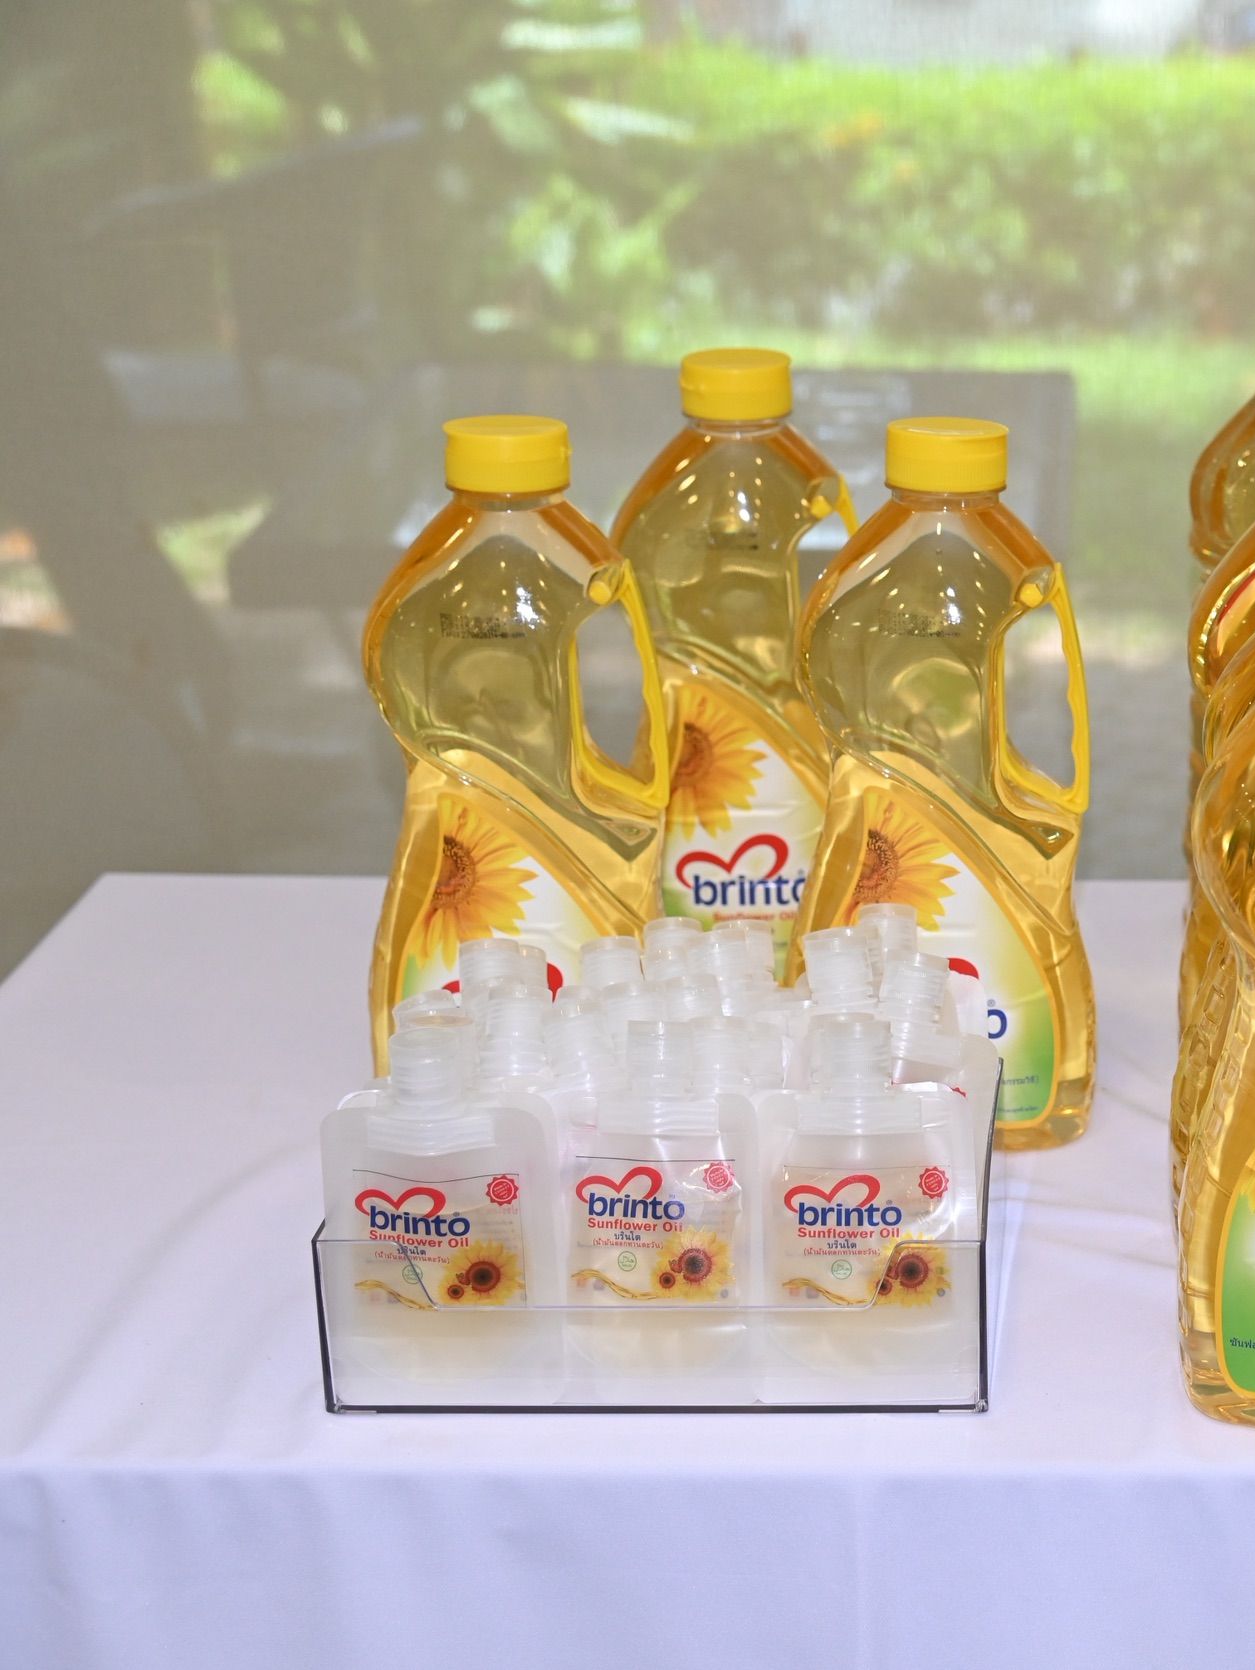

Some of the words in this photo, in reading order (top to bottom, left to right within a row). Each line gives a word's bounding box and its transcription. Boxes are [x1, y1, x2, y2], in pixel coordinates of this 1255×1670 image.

[588, 1193, 685, 1220] brinto
[798, 1202, 902, 1226] brinto
[370, 1205, 470, 1236] brinto
[588, 1218, 657, 1231] Sunflower
[370, 1230, 442, 1247] Sunflower
[448, 1238, 469, 1248] Oil
[798, 1227, 874, 1238] Sunflower
[880, 1228, 900, 1238] Oil
